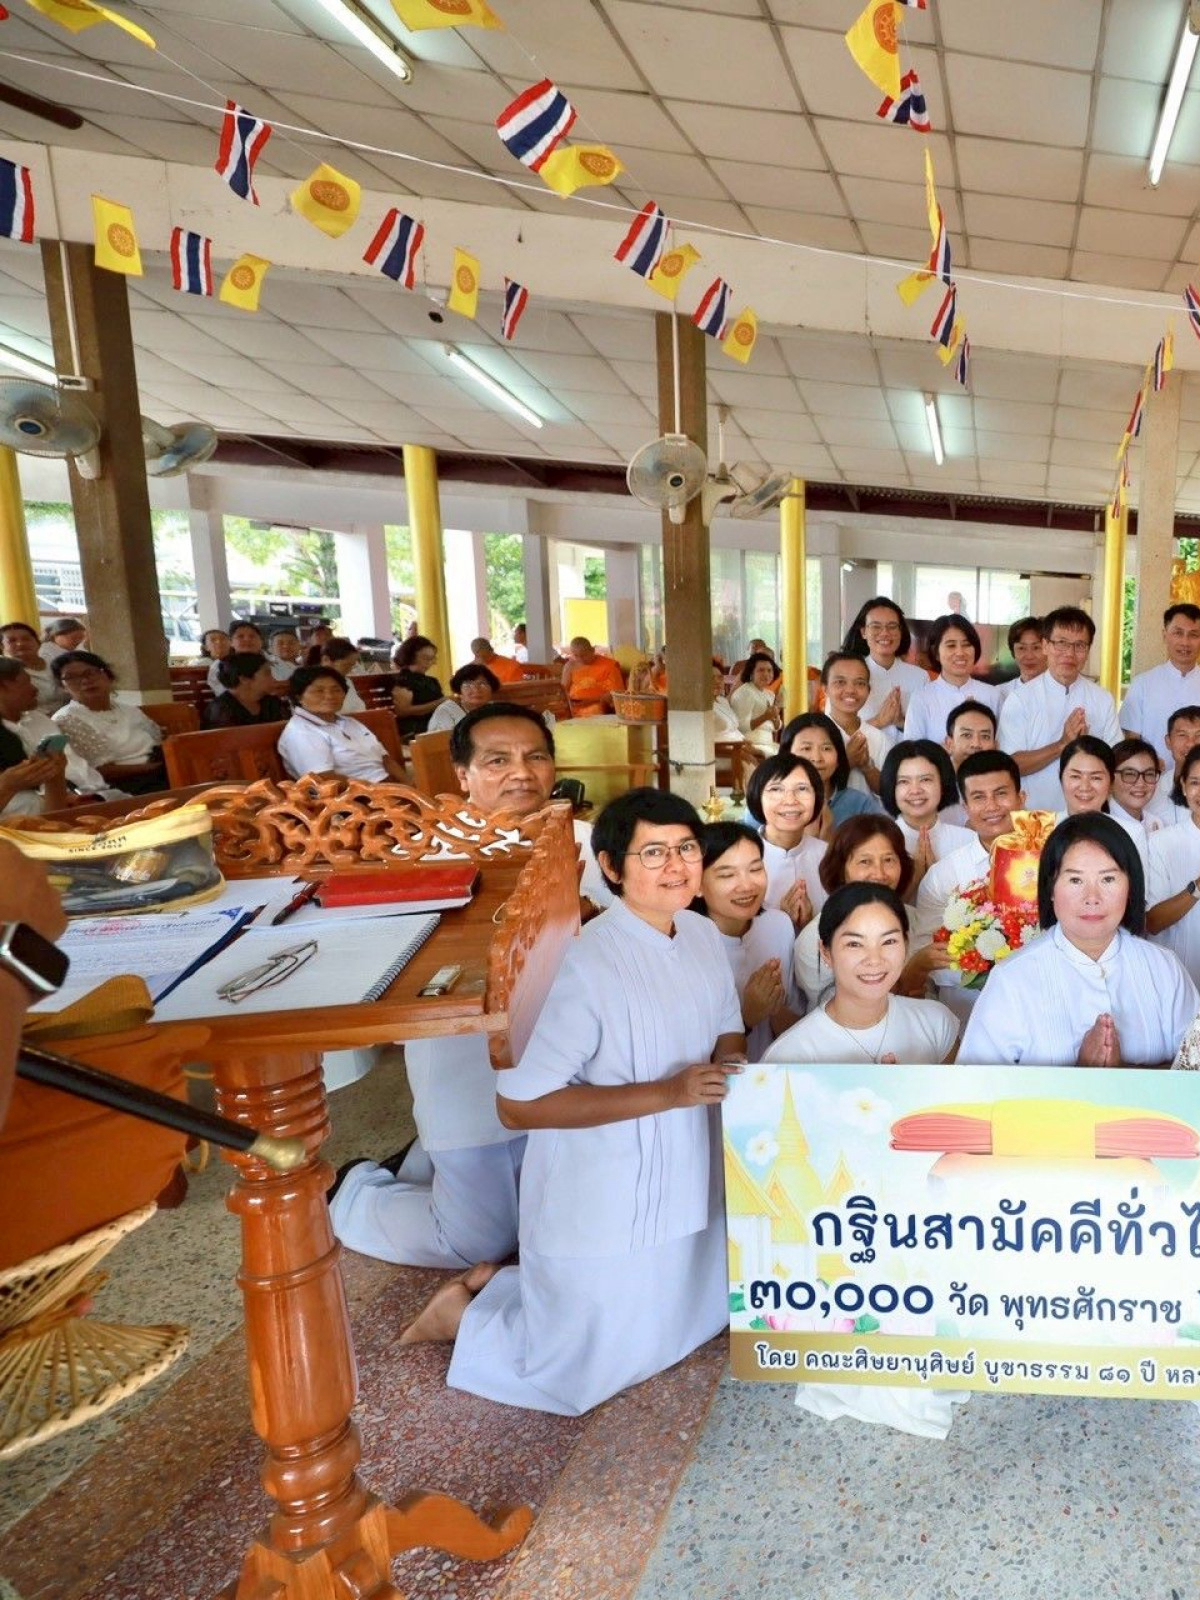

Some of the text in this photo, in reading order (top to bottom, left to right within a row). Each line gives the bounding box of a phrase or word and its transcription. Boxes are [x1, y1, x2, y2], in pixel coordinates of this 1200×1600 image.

[750, 1279, 934, 1318] ๓๐,๐๐๐
[948, 1281, 989, 1317] วัด
[1000, 1285, 1182, 1331] พุทธศักราช
[756, 1343, 797, 1367] โดย
[806, 1348, 975, 1379] คณะศิษยานุศิษย์
[984, 1358, 1089, 1384] บูชาธรรม
[1099, 1366, 1131, 1384] ๘๑
[1140, 1360, 1156, 1383] ปี
